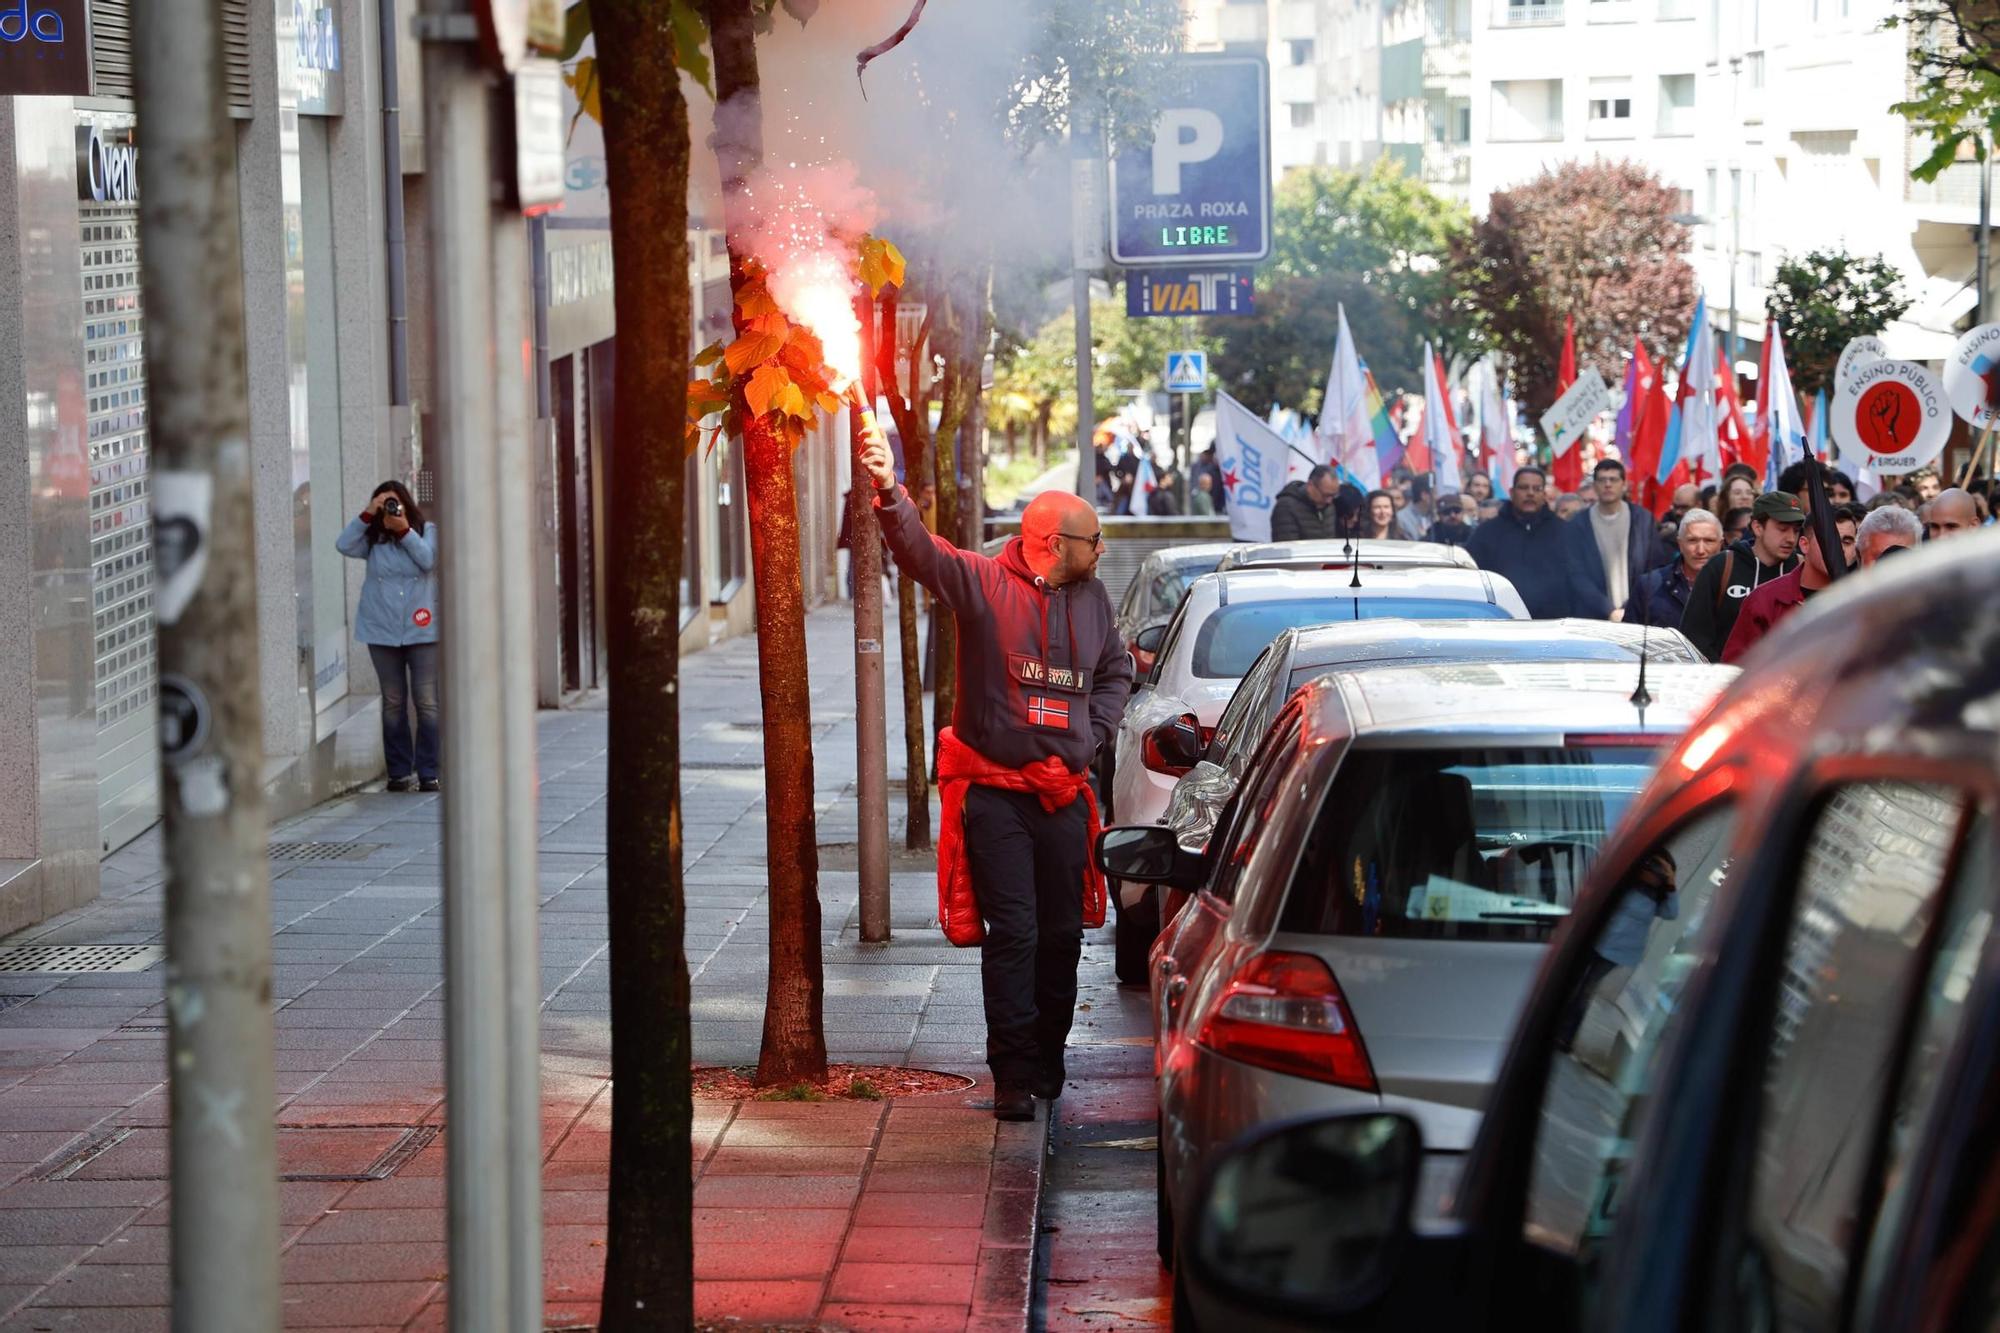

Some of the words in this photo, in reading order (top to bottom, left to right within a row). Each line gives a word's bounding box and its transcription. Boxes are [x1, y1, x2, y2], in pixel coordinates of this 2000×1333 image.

[1152, 108, 1224, 195] P
[1134, 203, 1194, 219] PRAZA
[1200, 201, 1248, 216] ROXA
[1162, 226, 1228, 246] LIBRE
[1959, 328, 2000, 365] ENSINO
[1848, 363, 1895, 396] ENSINO
[1899, 364, 1938, 418] PÚBLICO
